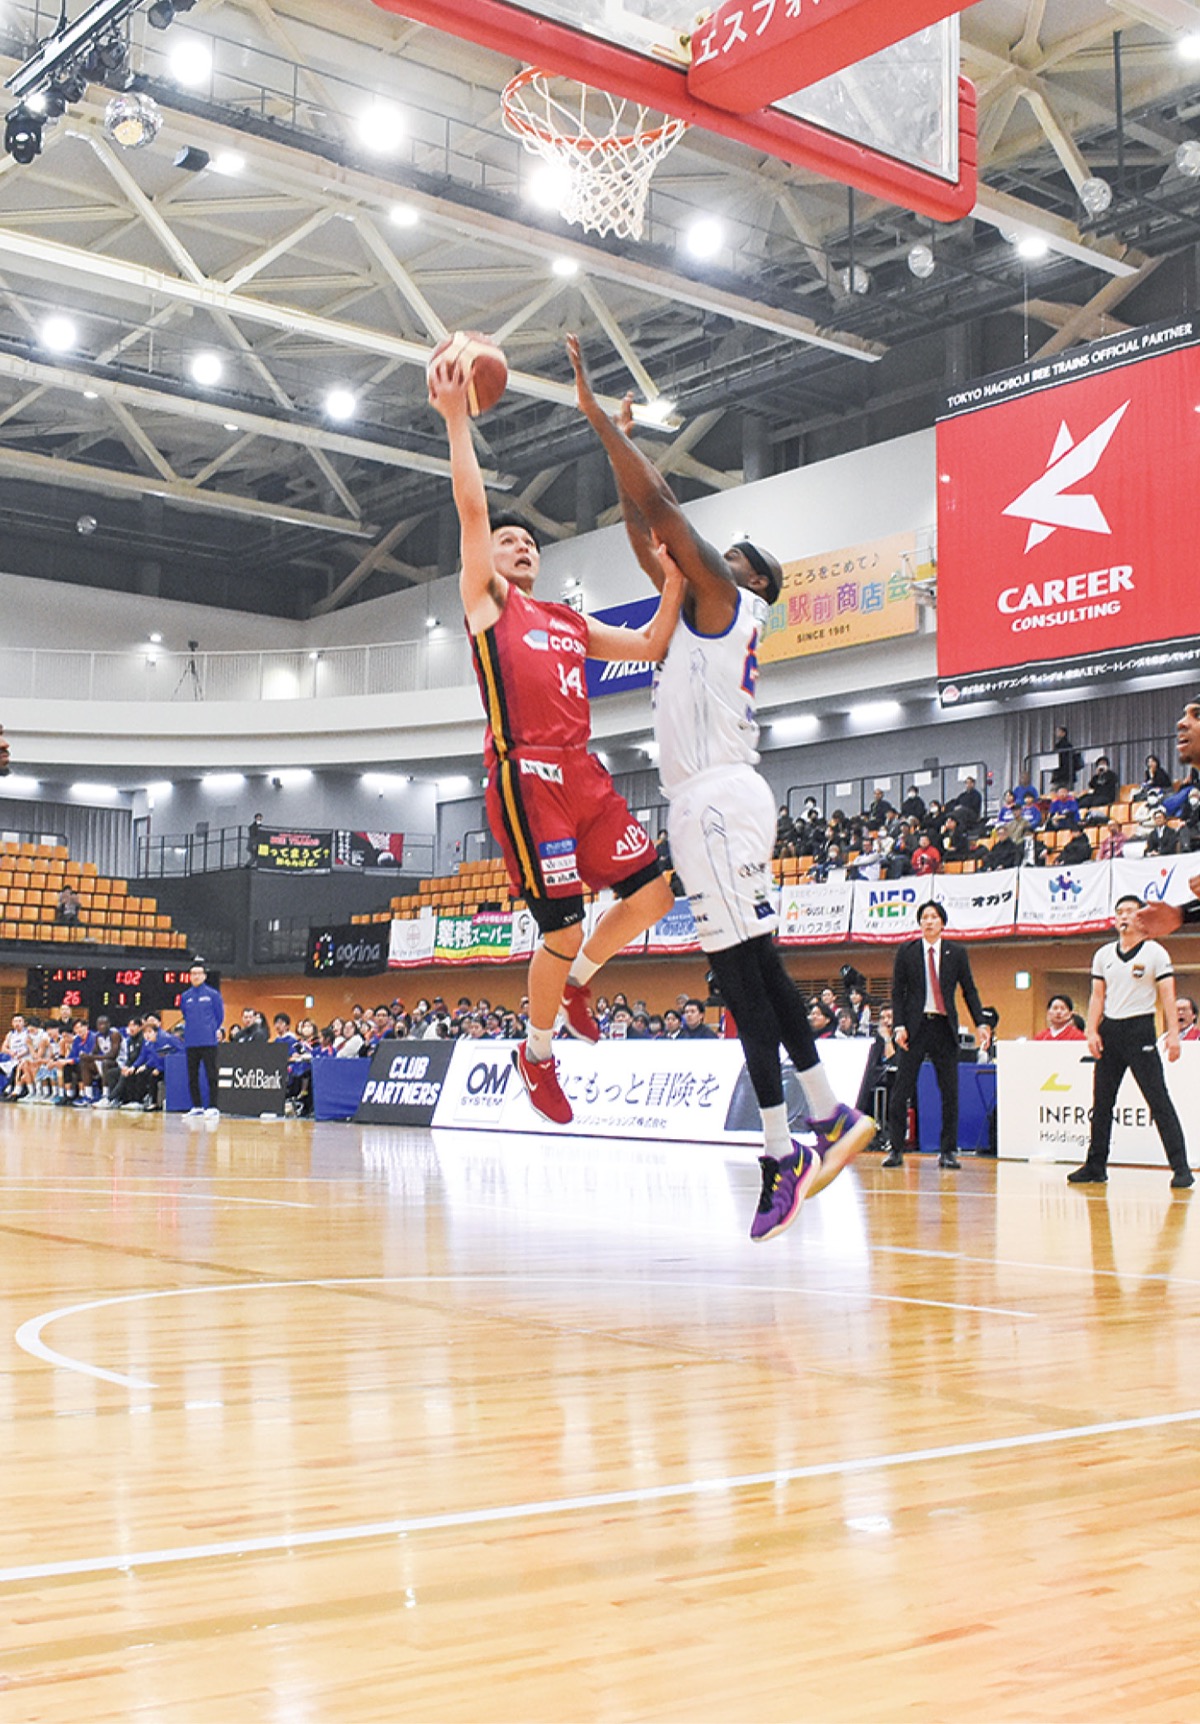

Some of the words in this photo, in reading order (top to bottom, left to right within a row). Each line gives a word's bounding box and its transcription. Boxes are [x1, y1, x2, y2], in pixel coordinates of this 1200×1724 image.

[694, 0, 821, 66] エスフォ
[947, 388, 982, 408] TOKYO
[983, 372, 1030, 397] HACHIOJI
[1032, 365, 1051, 383] BEE
[1052, 353, 1090, 376] TRAINS
[1091, 338, 1139, 363] OFFICIAL
[1141, 322, 1193, 347] PARTNER
[764, 569, 910, 636] 間駅前商店会
[997, 565, 1135, 614] CAREER
[1011, 600, 1121, 632] CONSULTING
[797, 628, 825, 643] SINCE
[828, 624, 851, 638] 1981
[556, 662, 585, 699] 14
[868, 888, 917, 918] NEP
[437, 917, 512, 948] 業務スーパー
[63, 990, 82, 1006] 26
[233, 1067, 282, 1089] SoftBank
[388, 1056, 430, 1079] CLUB
[466, 1062, 513, 1095] OM
[361, 1081, 441, 1106] PARTNERS
[553, 1060, 720, 1108] にもっと冒険を
[460, 1097, 503, 1107] SYSTEM
